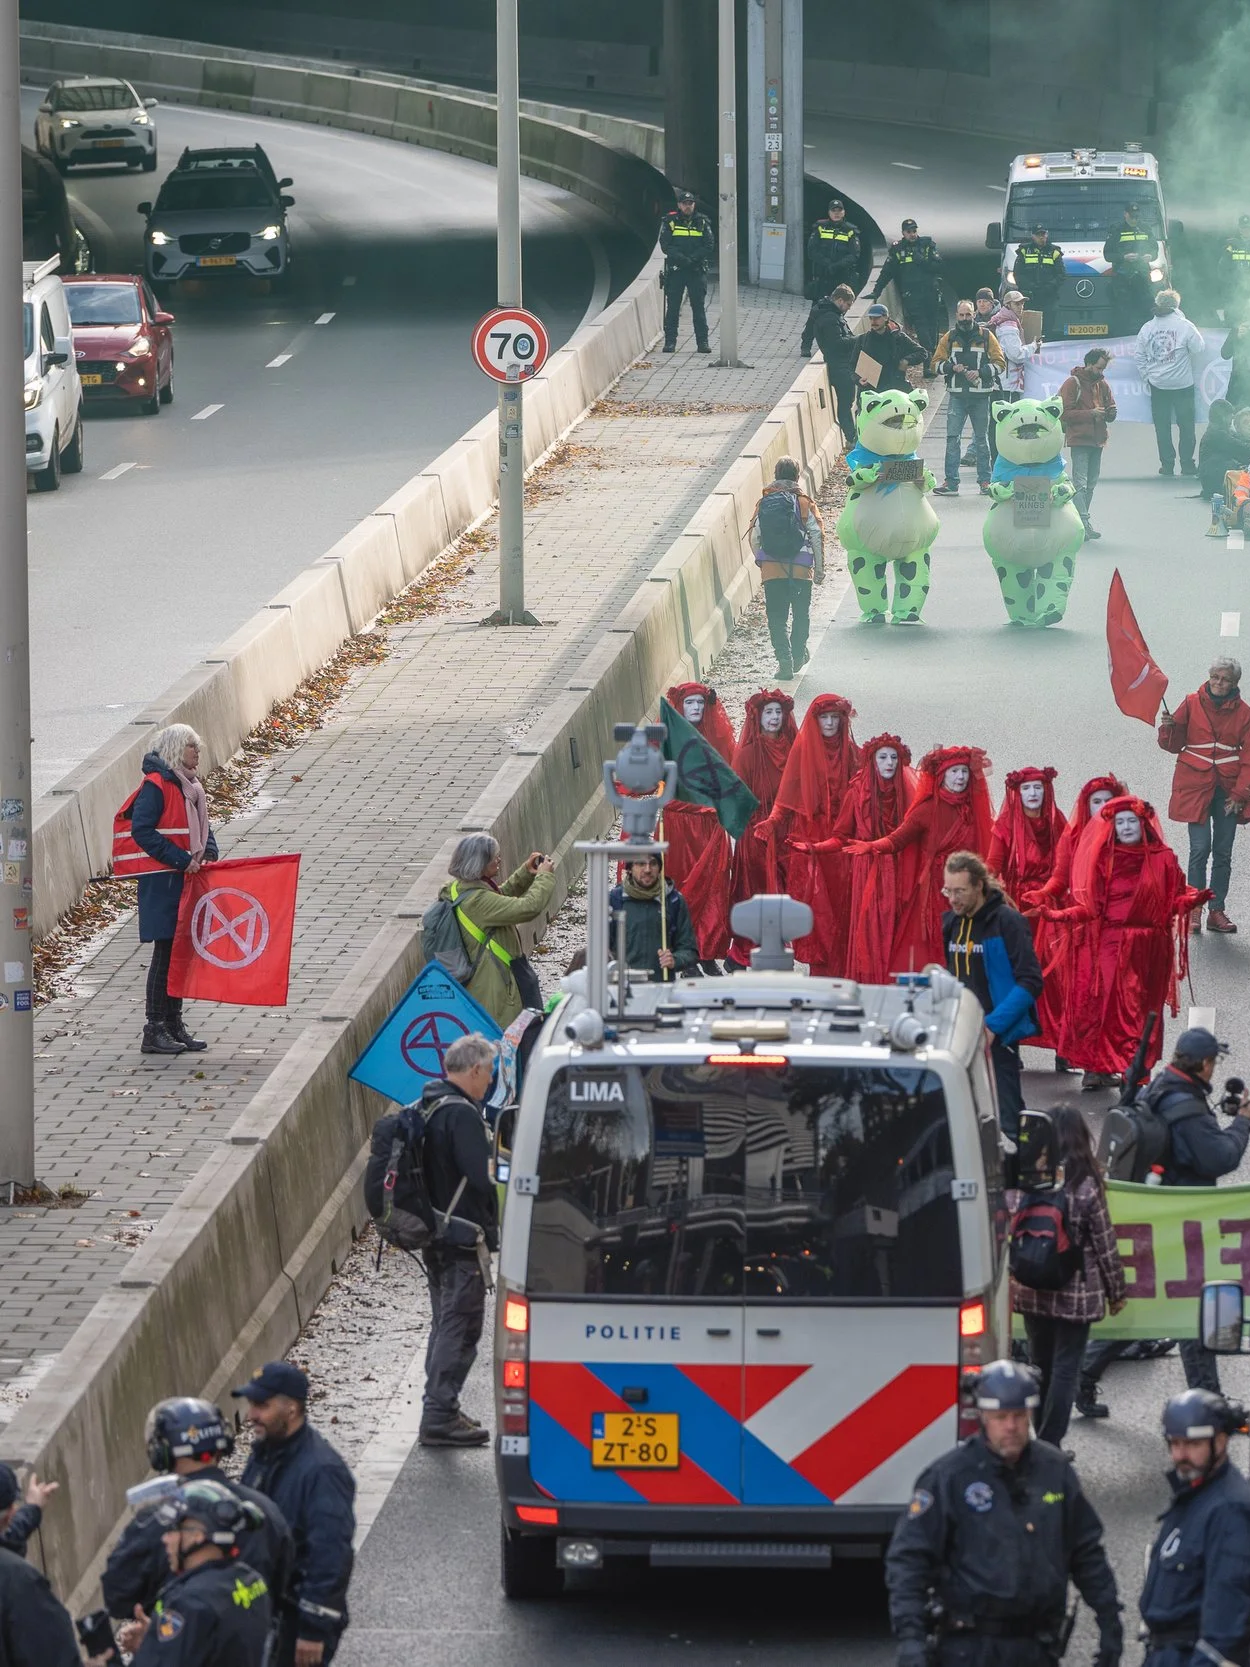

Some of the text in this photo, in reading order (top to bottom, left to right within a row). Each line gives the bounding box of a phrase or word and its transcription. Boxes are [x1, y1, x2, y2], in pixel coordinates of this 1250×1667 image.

[490, 333, 534, 360] 70
[80, 375, 97, 384] -TG
[1018, 501, 1045, 509] KINGS
[1025, 493, 1037, 502] NO
[570, 1080, 624, 1102] LIMA
[585, 1325, 682, 1341] POLITIE
[603, 1442, 668, 1462] ZT-80
